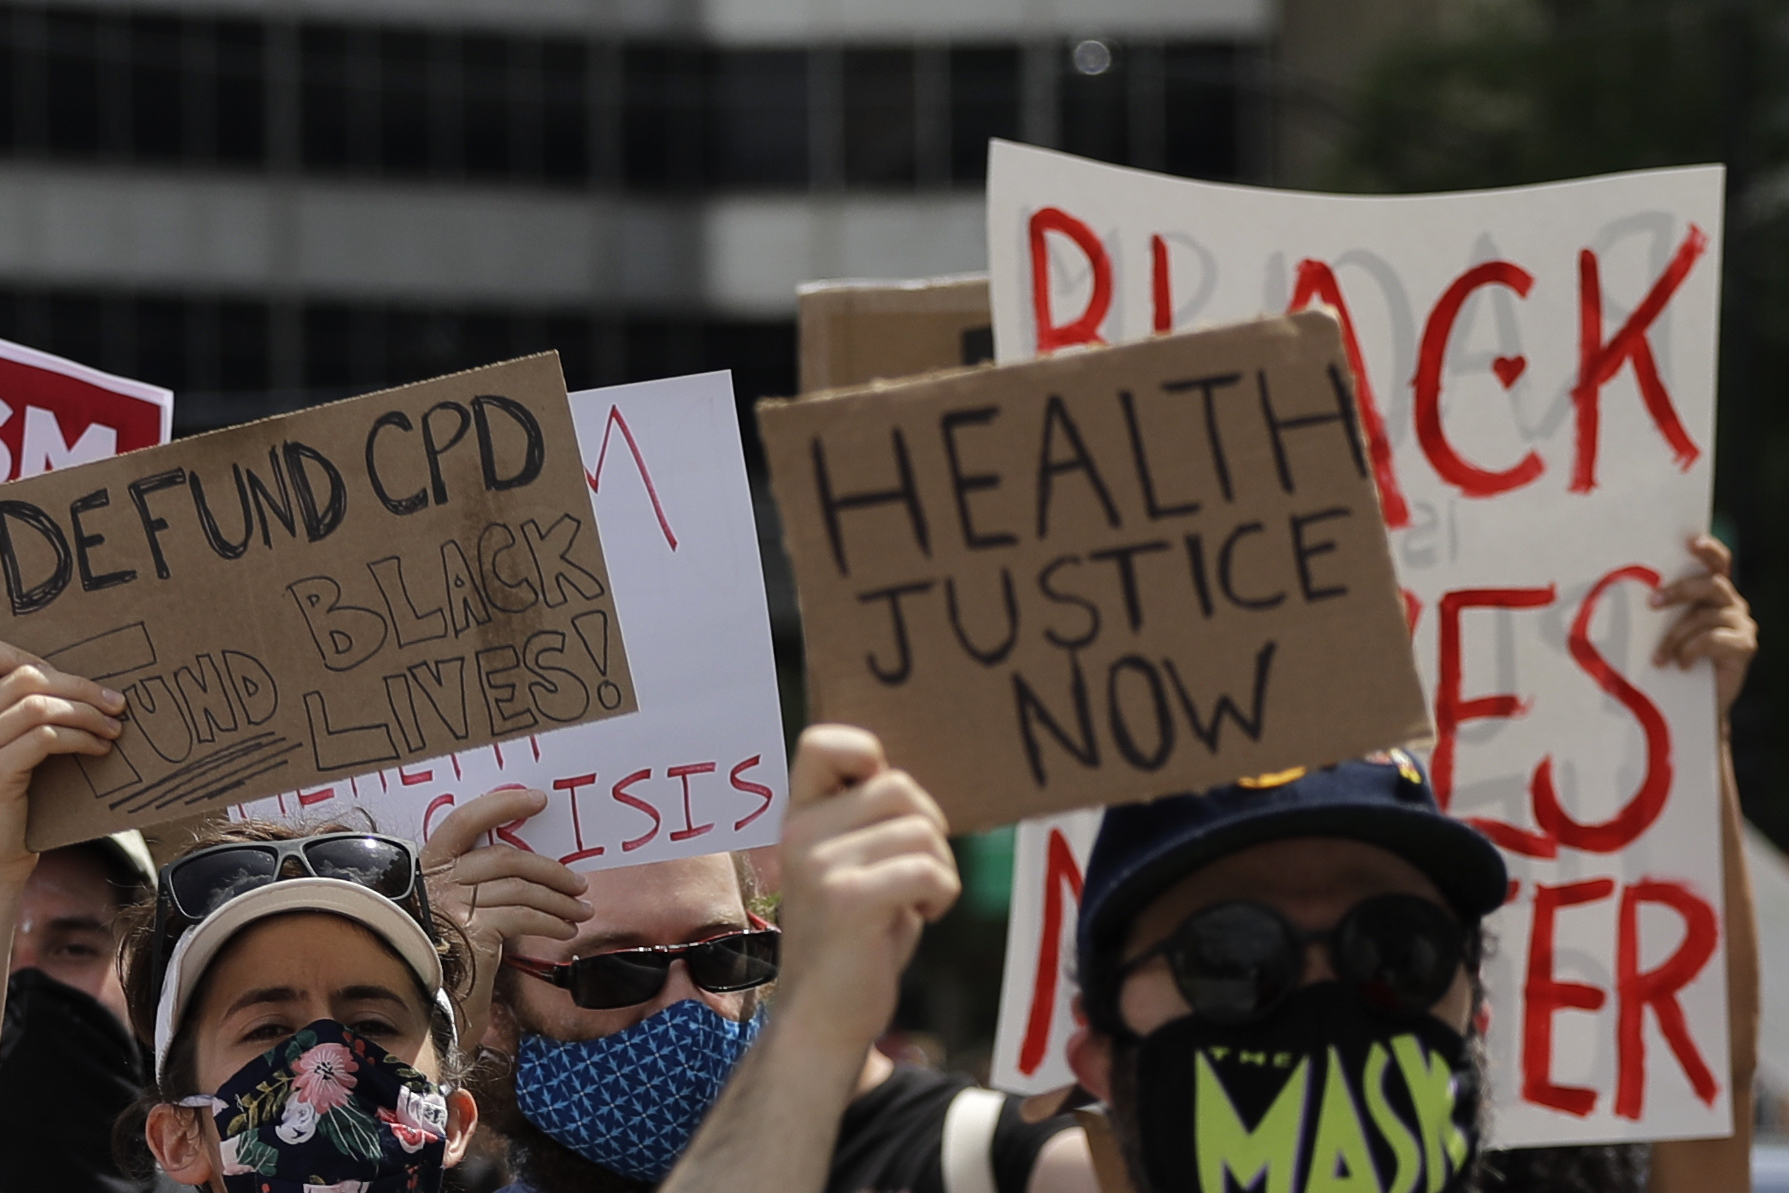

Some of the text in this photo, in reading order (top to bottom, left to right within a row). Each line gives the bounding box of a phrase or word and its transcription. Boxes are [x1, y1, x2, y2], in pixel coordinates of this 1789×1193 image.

[366, 394, 546, 516] CPD
[810, 363, 1369, 578] HEALTH
[287, 512, 606, 672] BLACK
[857, 507, 1353, 688] JUSTICE
[44, 621, 278, 798] FUND
[303, 610, 622, 773] LIVES!
[1011, 641, 1277, 789] NOW
[1211, 1045, 1292, 1067] THE
